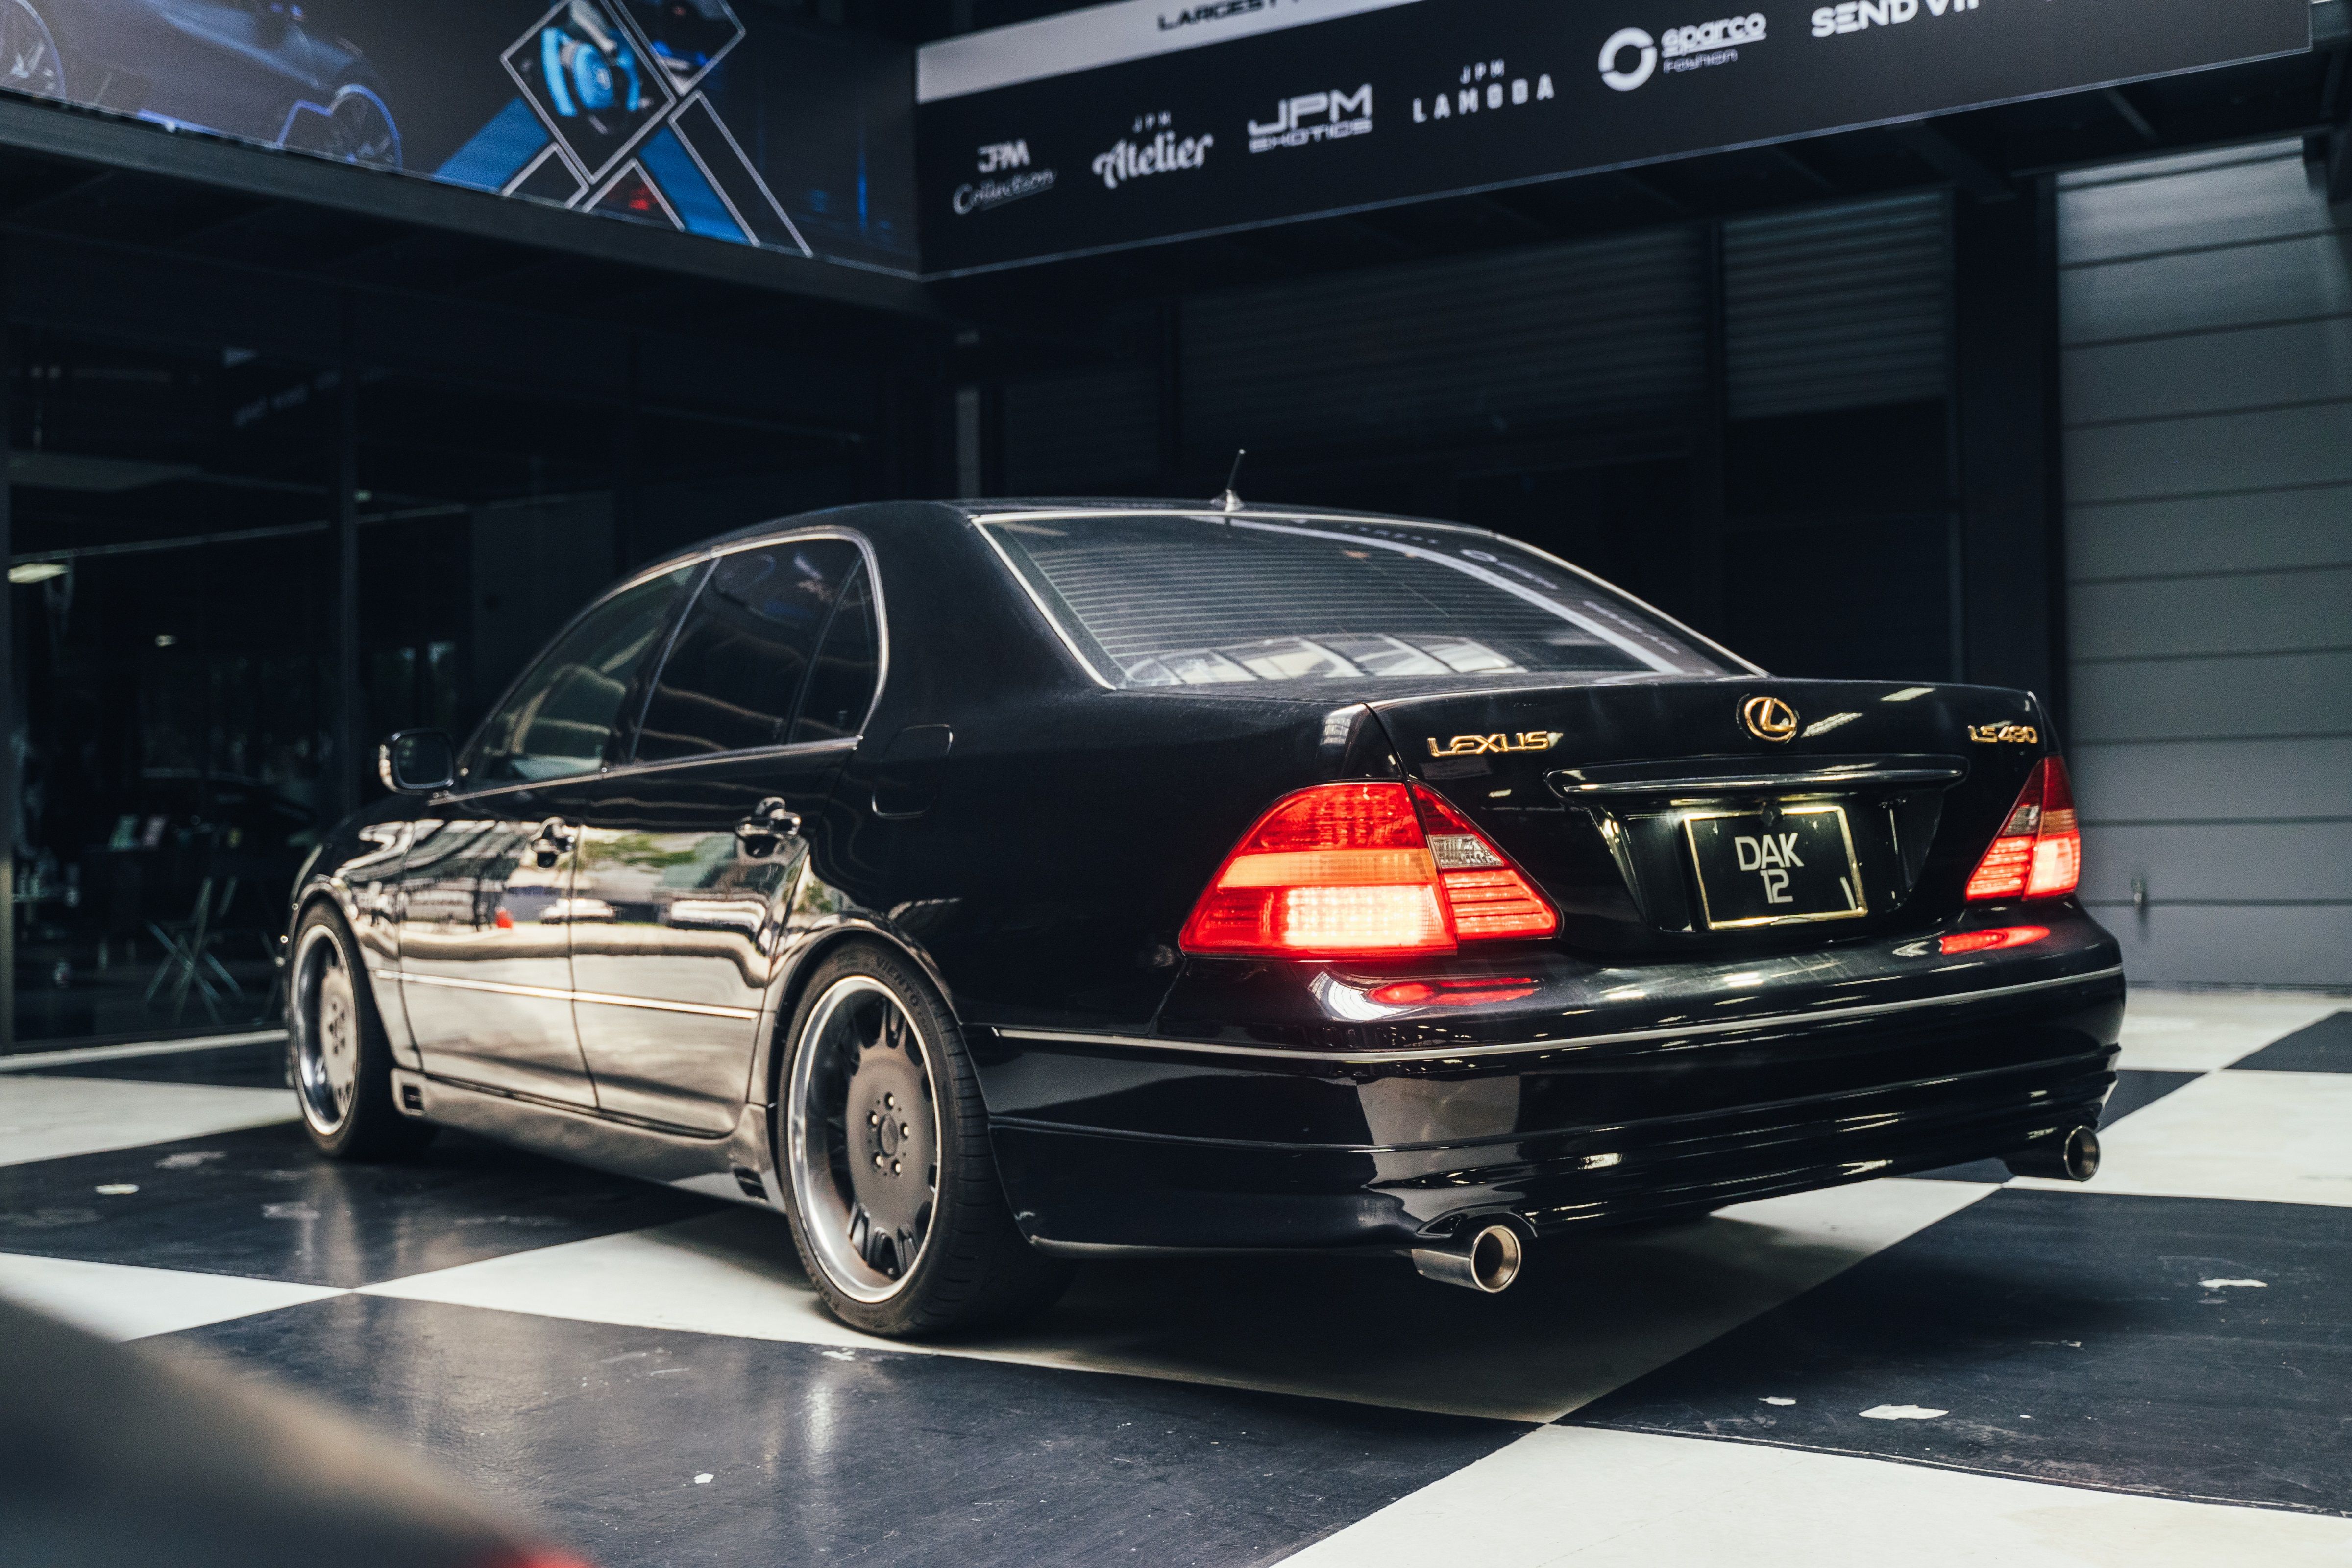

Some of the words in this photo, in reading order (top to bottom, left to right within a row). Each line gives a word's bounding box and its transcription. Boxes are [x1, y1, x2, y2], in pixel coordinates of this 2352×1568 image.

[1661, 12, 1766, 57] sparco
[1460, 58, 1505, 84] JPM
[1132, 110, 1172, 133] JPM
[1248, 83, 1372, 137] JPM
[977, 139, 1031, 173] JPM
[1092, 131, 1214, 190] Atelier
[1427, 731, 1549, 757] LEXUS
[1734, 833, 1805, 871] DAK
[1760, 868, 1793, 904] 12
